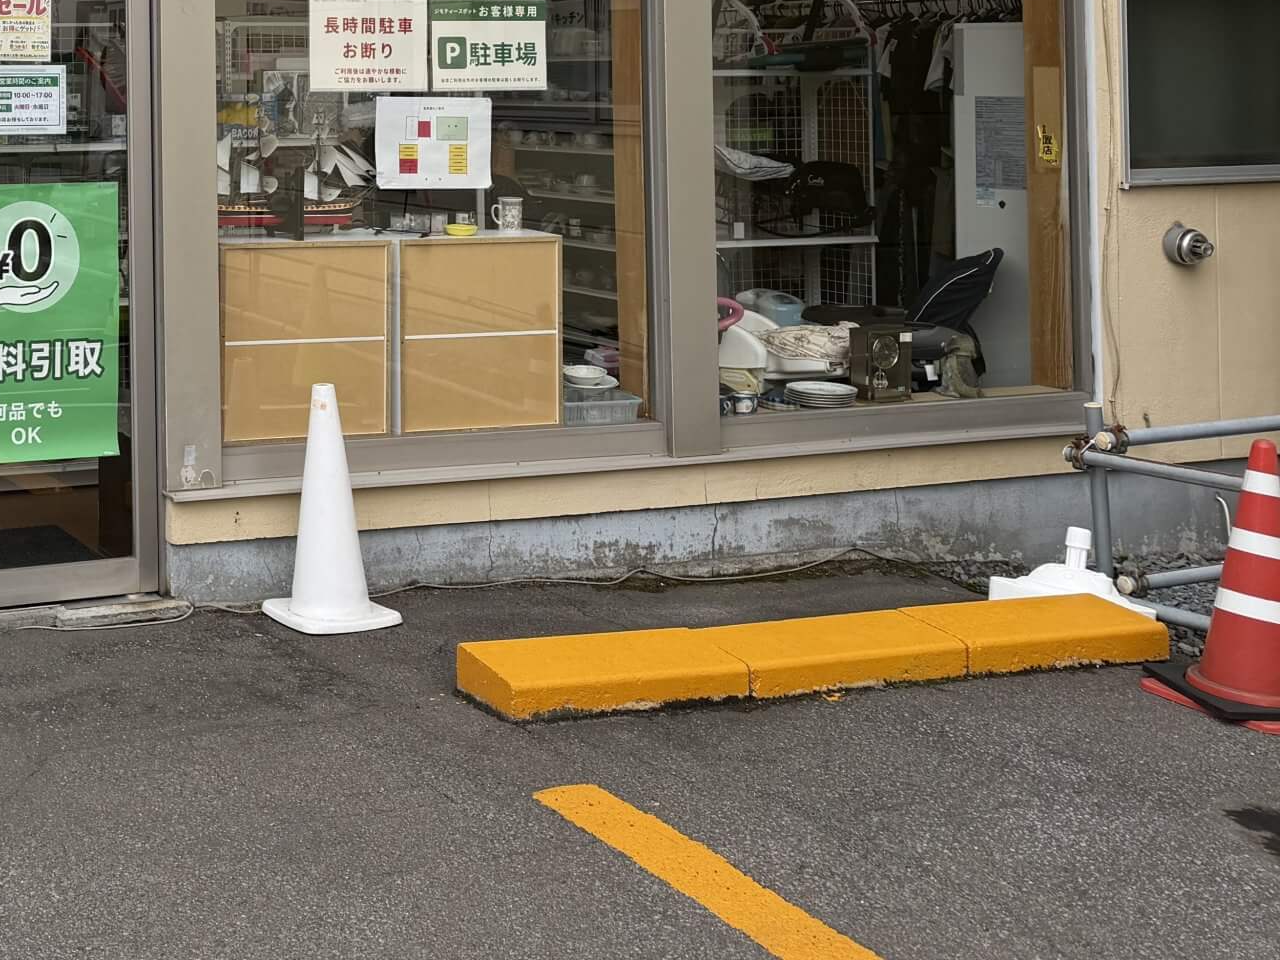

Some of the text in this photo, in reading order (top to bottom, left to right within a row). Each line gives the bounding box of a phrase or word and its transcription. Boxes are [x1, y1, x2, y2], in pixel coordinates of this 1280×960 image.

[478, 5, 538, 18] お客様専用
[324, 17, 413, 35] 長時間駐車
[342, 42, 393, 60] お断り
[446, 42, 461, 65] P
[469, 42, 537, 67] 駐車場
[11, 427, 42, 445] OK
